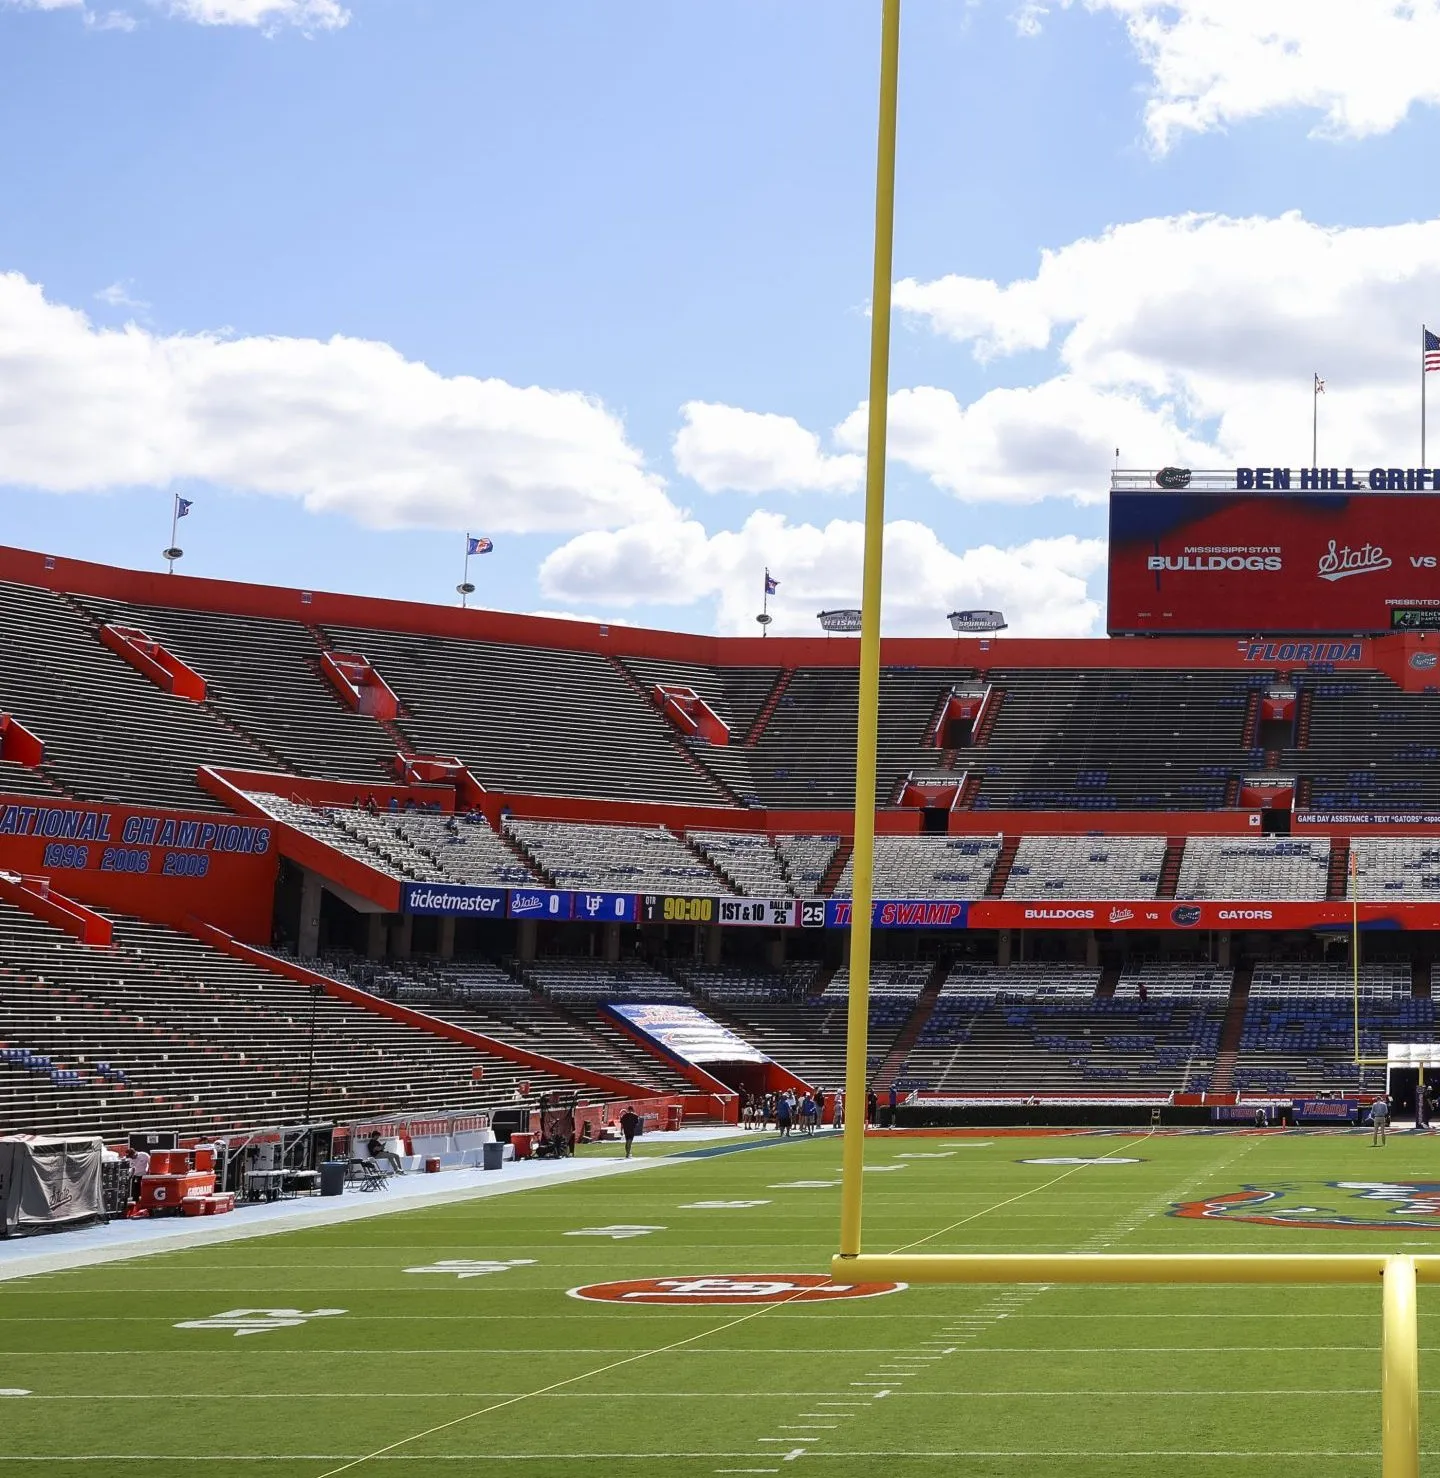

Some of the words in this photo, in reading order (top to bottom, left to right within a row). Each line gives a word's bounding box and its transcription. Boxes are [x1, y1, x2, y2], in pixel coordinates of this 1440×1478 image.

[1236, 467, 1290, 490] BEN
[1301, 467, 1360, 490] HILL
[1184, 546, 1247, 554] MISSISSIPPI
[1248, 546, 1281, 554] STATE
[1147, 556, 1282, 571] BULLDOGS
[1317, 539, 1393, 582] State
[1245, 643, 1362, 661] FLORIDA
[1297, 815, 1316, 823] GAME
[1316, 815, 1329, 823] DAY
[1330, 815, 1369, 823] ASSISTANCE
[1374, 815, 1390, 823] TEXT
[0, 803, 110, 843] ATIONAL
[122, 815, 271, 855] CHAMPIONS
[43, 842, 88, 870] 1996
[100, 846, 151, 874] 2006
[163, 852, 210, 878] 2008
[410, 889, 500, 912] ticketmaster
[511, 893, 543, 913] State
[549, 894, 560, 914] 0
[614, 898, 625, 917] 0
[663, 897, 712, 921] 90:00
[769, 900, 783, 910] BALL
[784, 901, 793, 911] ON
[647, 906, 653, 920] 1
[721, 902, 742, 920] 1ST
[742, 906, 751, 920] &
[752, 903, 764, 921] 10
[774, 910, 787, 924] 25
[803, 907, 823, 922] 25
[881, 903, 961, 925] SWAMP
[1024, 909, 1095, 919] BULLDOGS
[1109, 906, 1134, 923] State
[1218, 910, 1273, 920] GATORS
